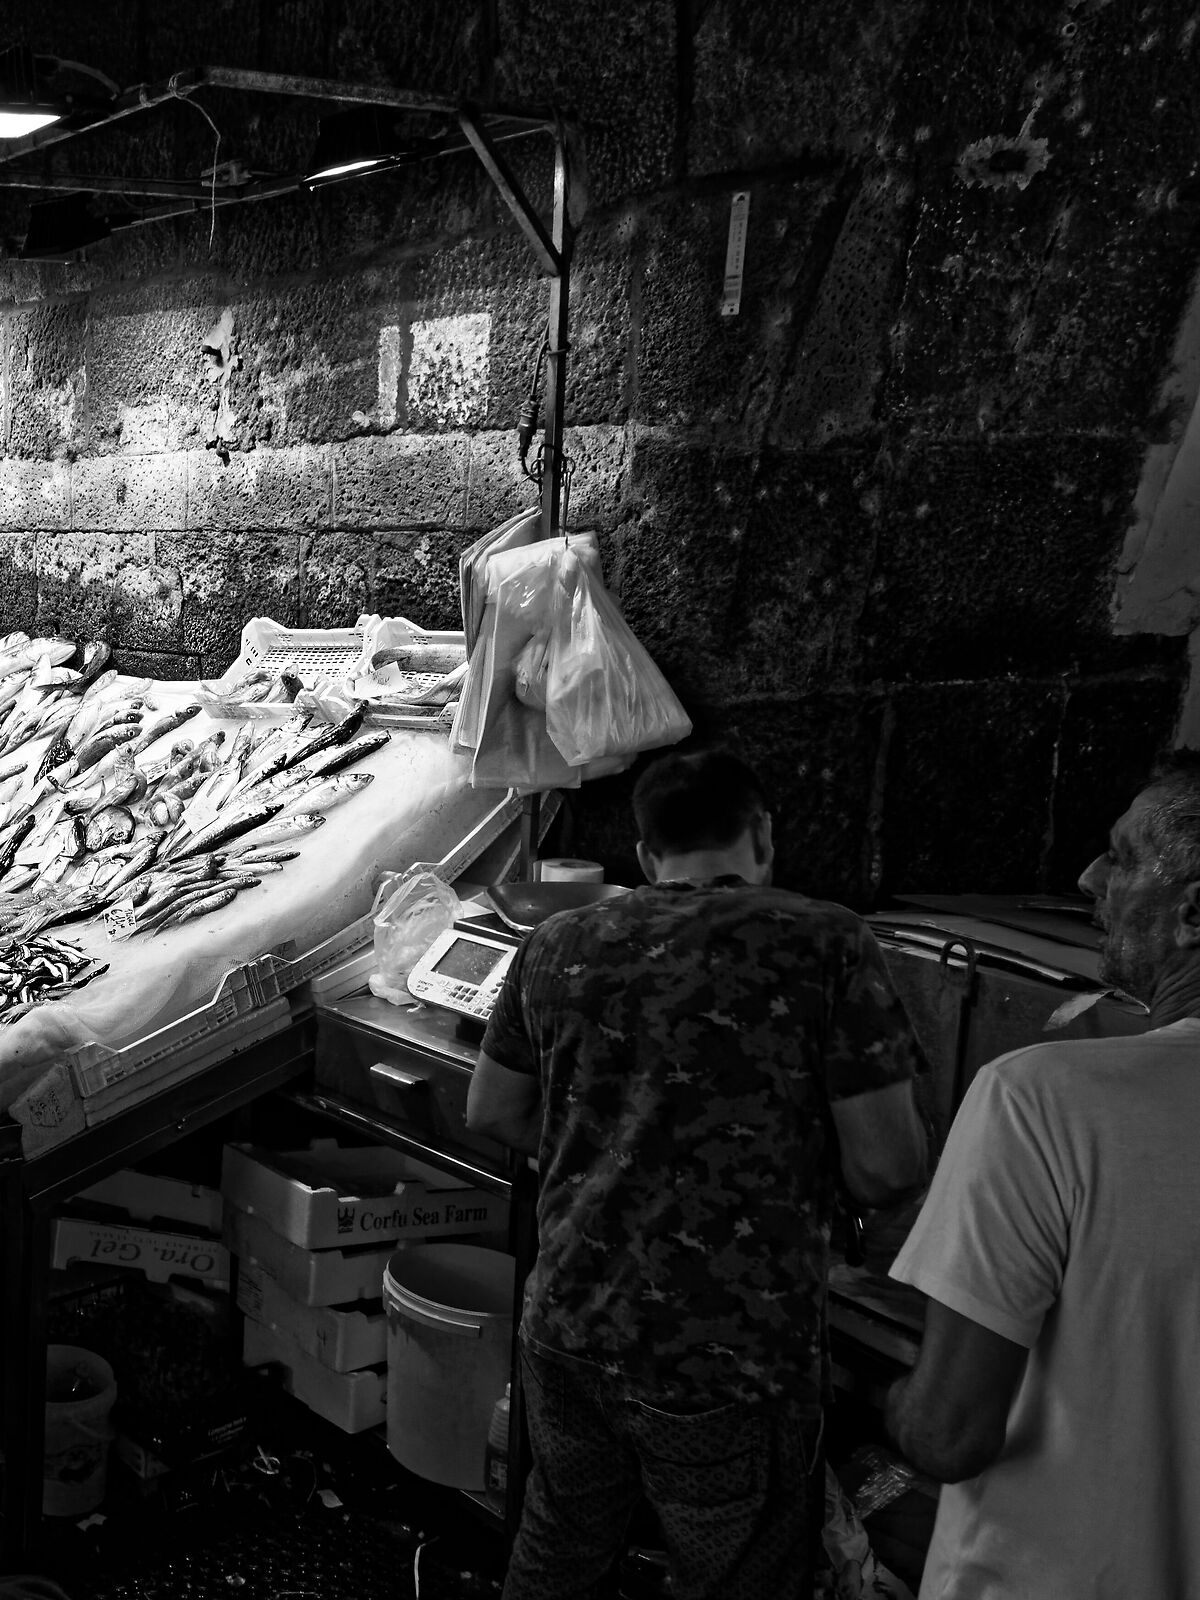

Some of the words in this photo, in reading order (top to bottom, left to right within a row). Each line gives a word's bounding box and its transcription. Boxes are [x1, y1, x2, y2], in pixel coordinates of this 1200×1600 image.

[360, 1208, 407, 1232] Corfu
[412, 1206, 440, 1226] Sea
[445, 1204, 488, 1224] Farm
[90, 1239, 140, 1261] Gel
[153, 1248, 215, 1272] Ora.
